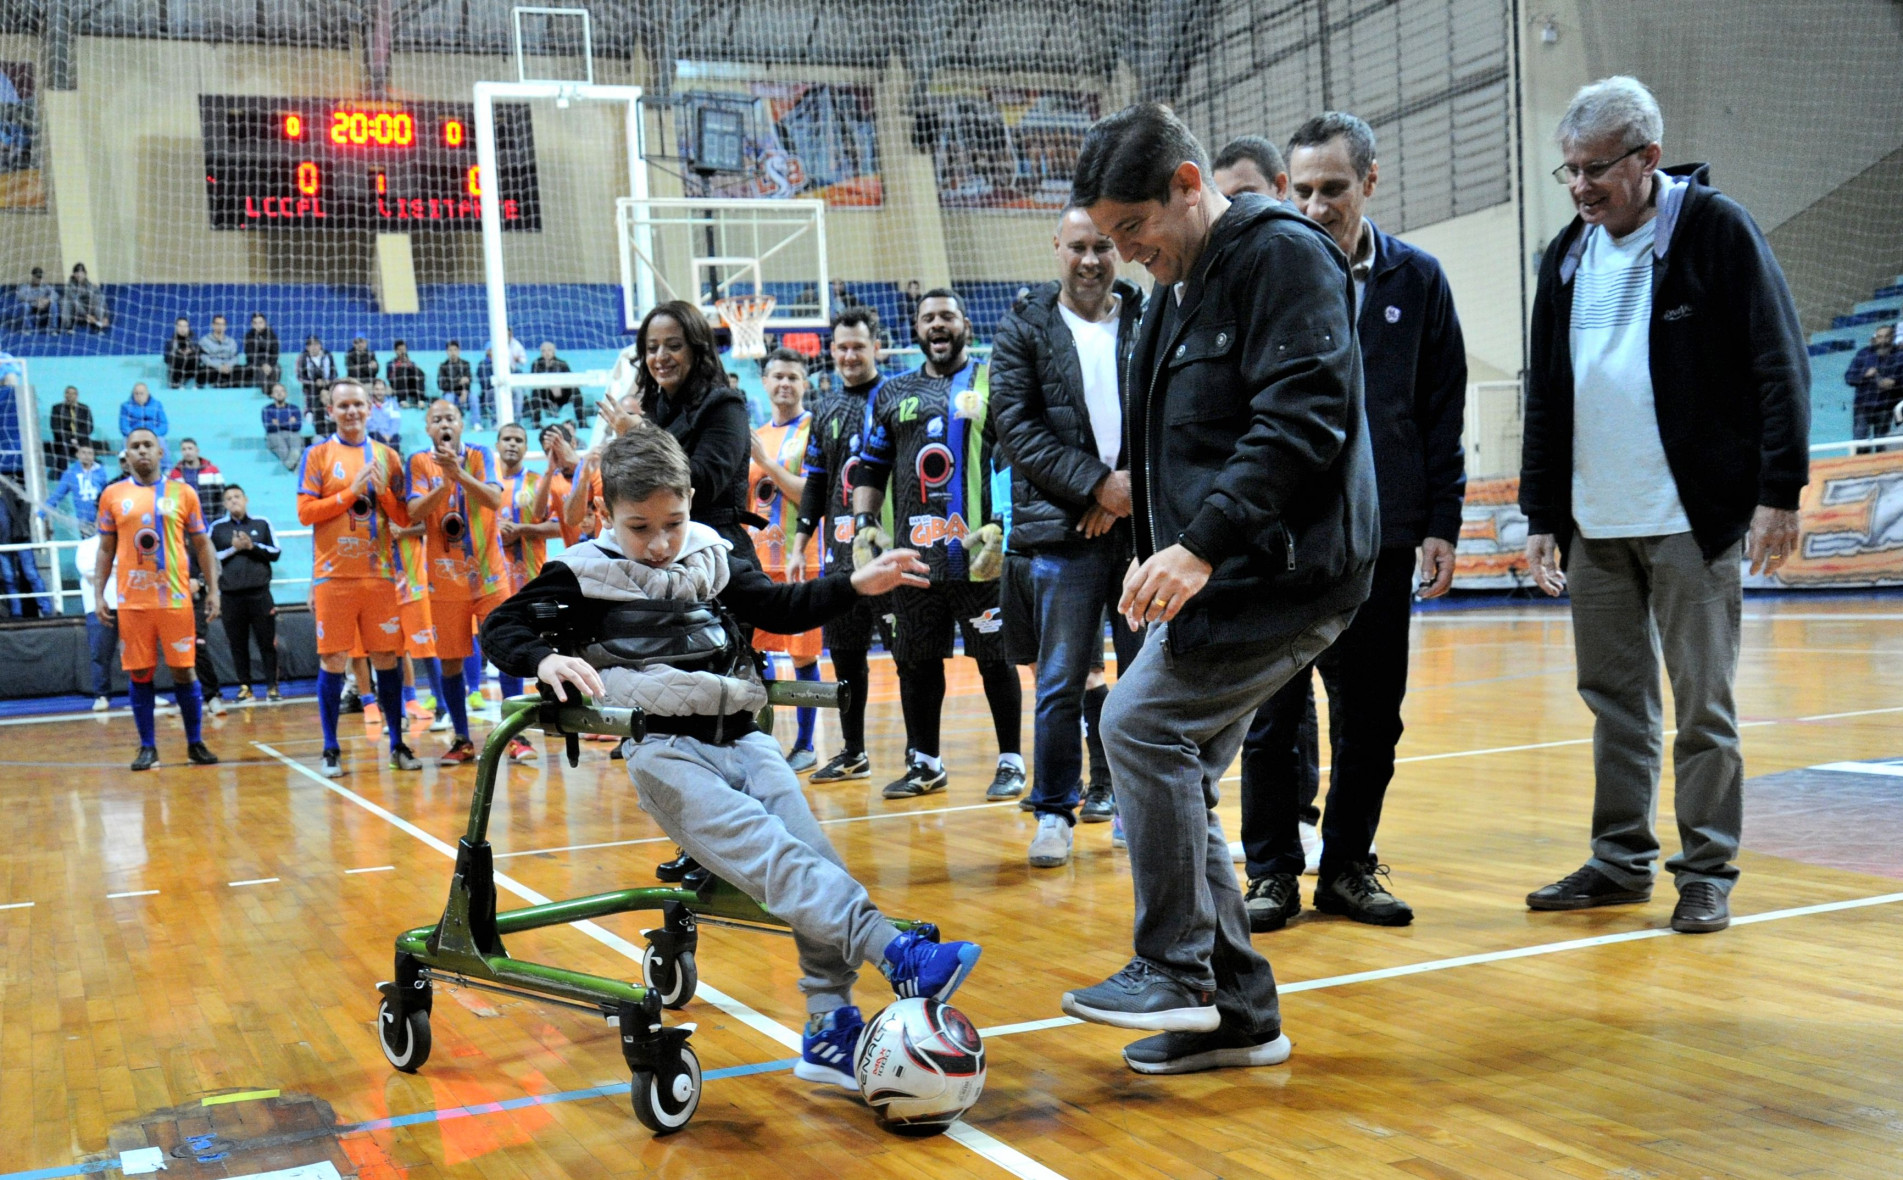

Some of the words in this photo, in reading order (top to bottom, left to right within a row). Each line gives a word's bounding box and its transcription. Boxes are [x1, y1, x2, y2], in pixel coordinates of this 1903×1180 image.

[286, 116, 301, 137] 0
[330, 112, 412, 145] 20:00
[445, 121, 462, 145] 0
[298, 162, 317, 194] 0
[377, 174, 385, 193] 1
[899, 396, 919, 422] 12
[831, 417, 839, 439] 1
[333, 462, 345, 479] 4
[122, 498, 133, 515] 9
[911, 513, 969, 547] GIBA
